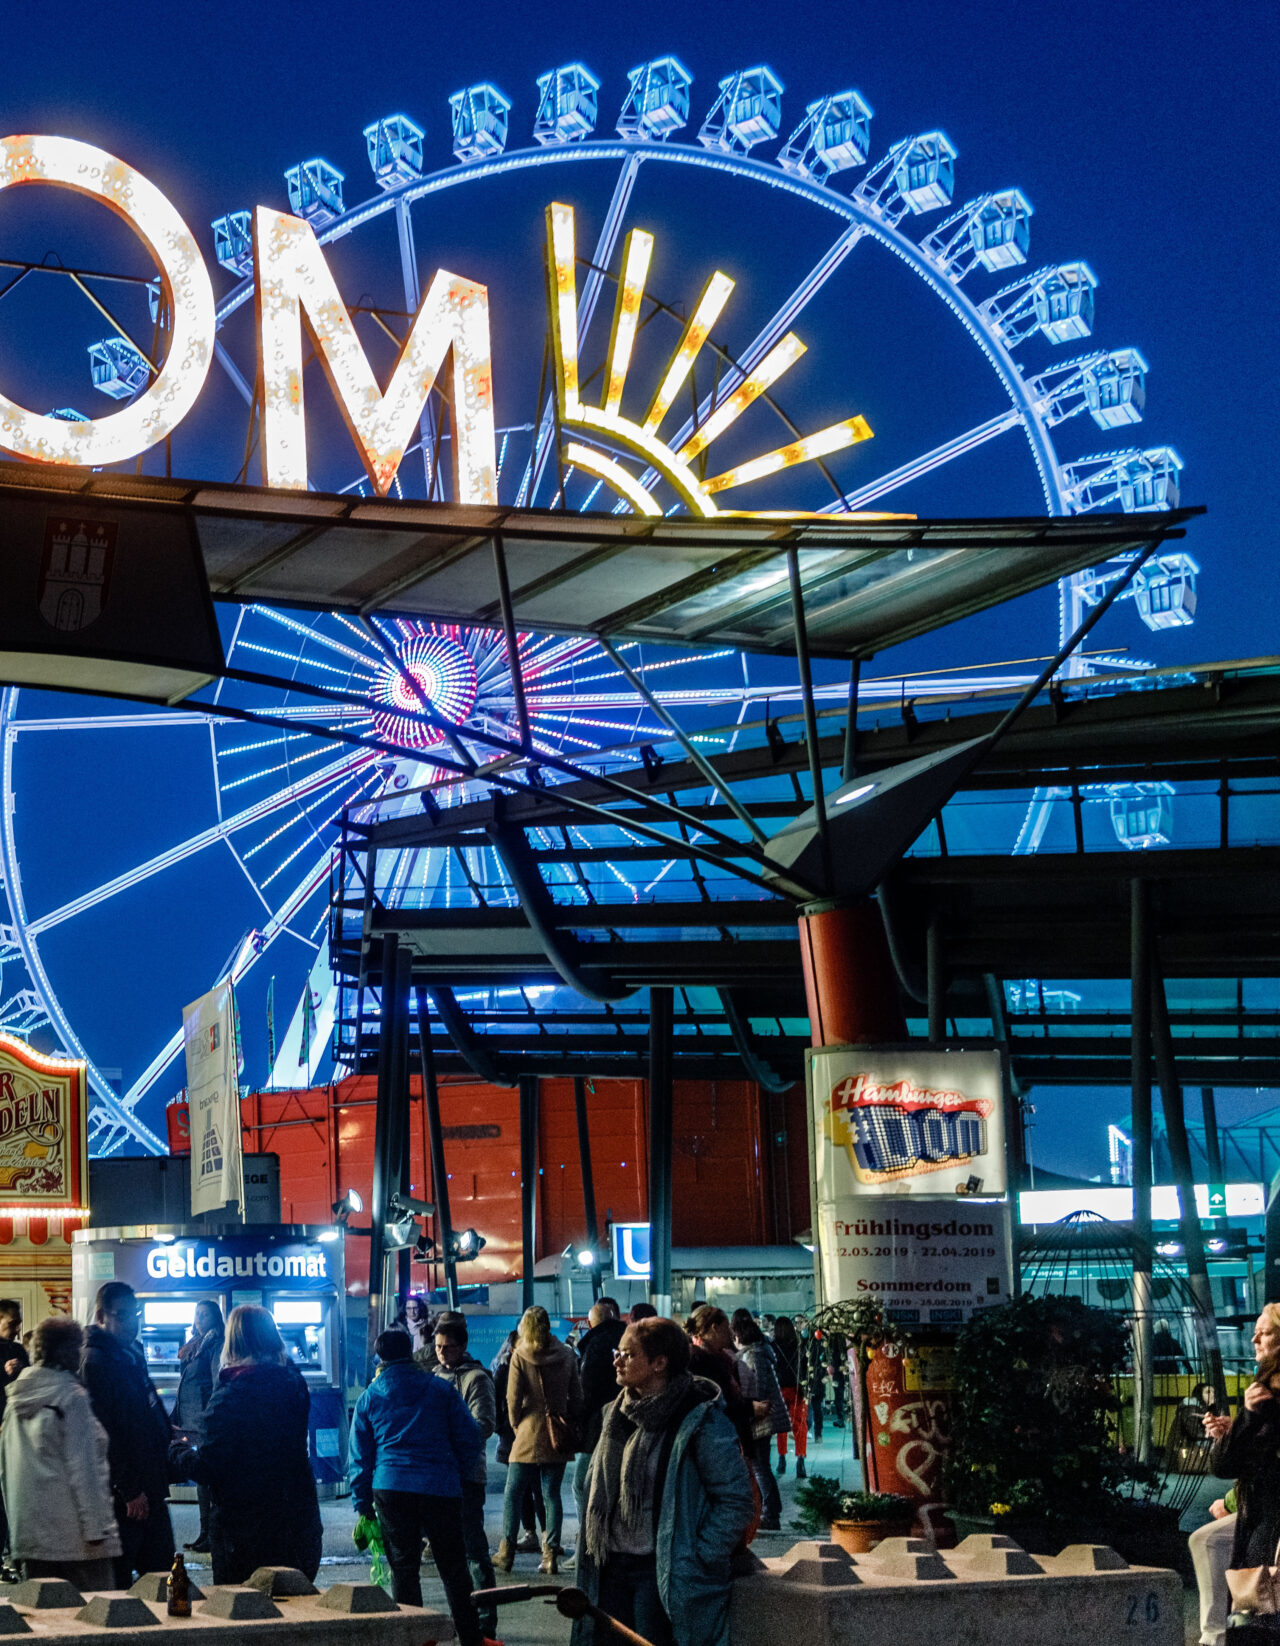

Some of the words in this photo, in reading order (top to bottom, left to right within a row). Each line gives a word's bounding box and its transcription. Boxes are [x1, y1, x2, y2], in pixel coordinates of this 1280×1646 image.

[837, 1077, 966, 1107] Hamburger
[834, 1219, 993, 1240] Frühlingsdom
[922, 1247, 996, 1257] 22.04.2019
[147, 1248, 327, 1279] Geldautomat
[1154, 1266, 1187, 1274] Ausgng
[857, 1279, 972, 1292] Sommerdom
